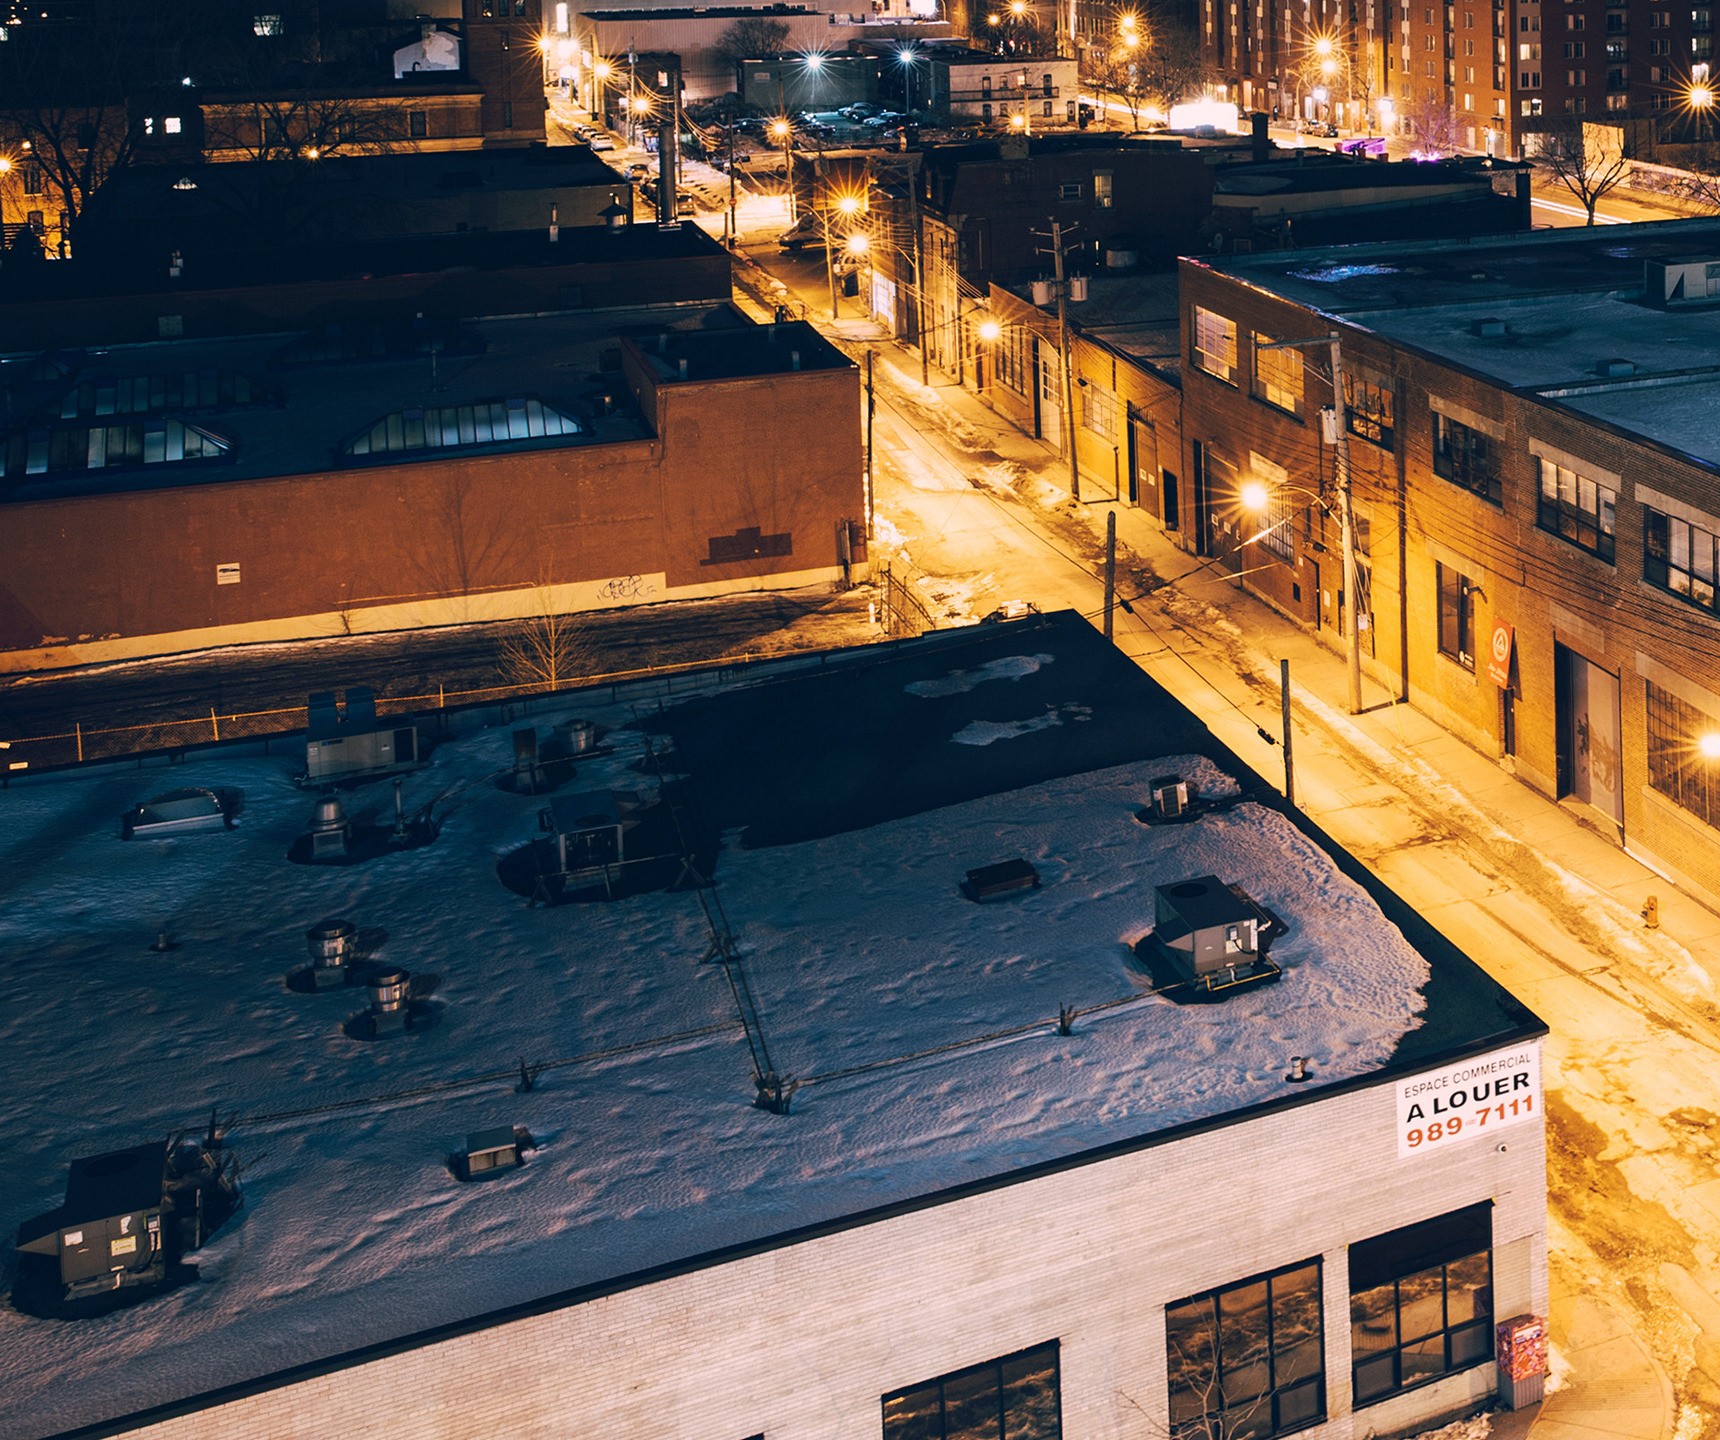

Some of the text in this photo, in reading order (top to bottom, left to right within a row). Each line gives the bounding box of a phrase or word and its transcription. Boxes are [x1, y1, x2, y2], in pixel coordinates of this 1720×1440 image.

[1404, 1053, 1532, 1099] ESPACE COMMERCIAL
[1407, 1072, 1530, 1123] A LOUER
